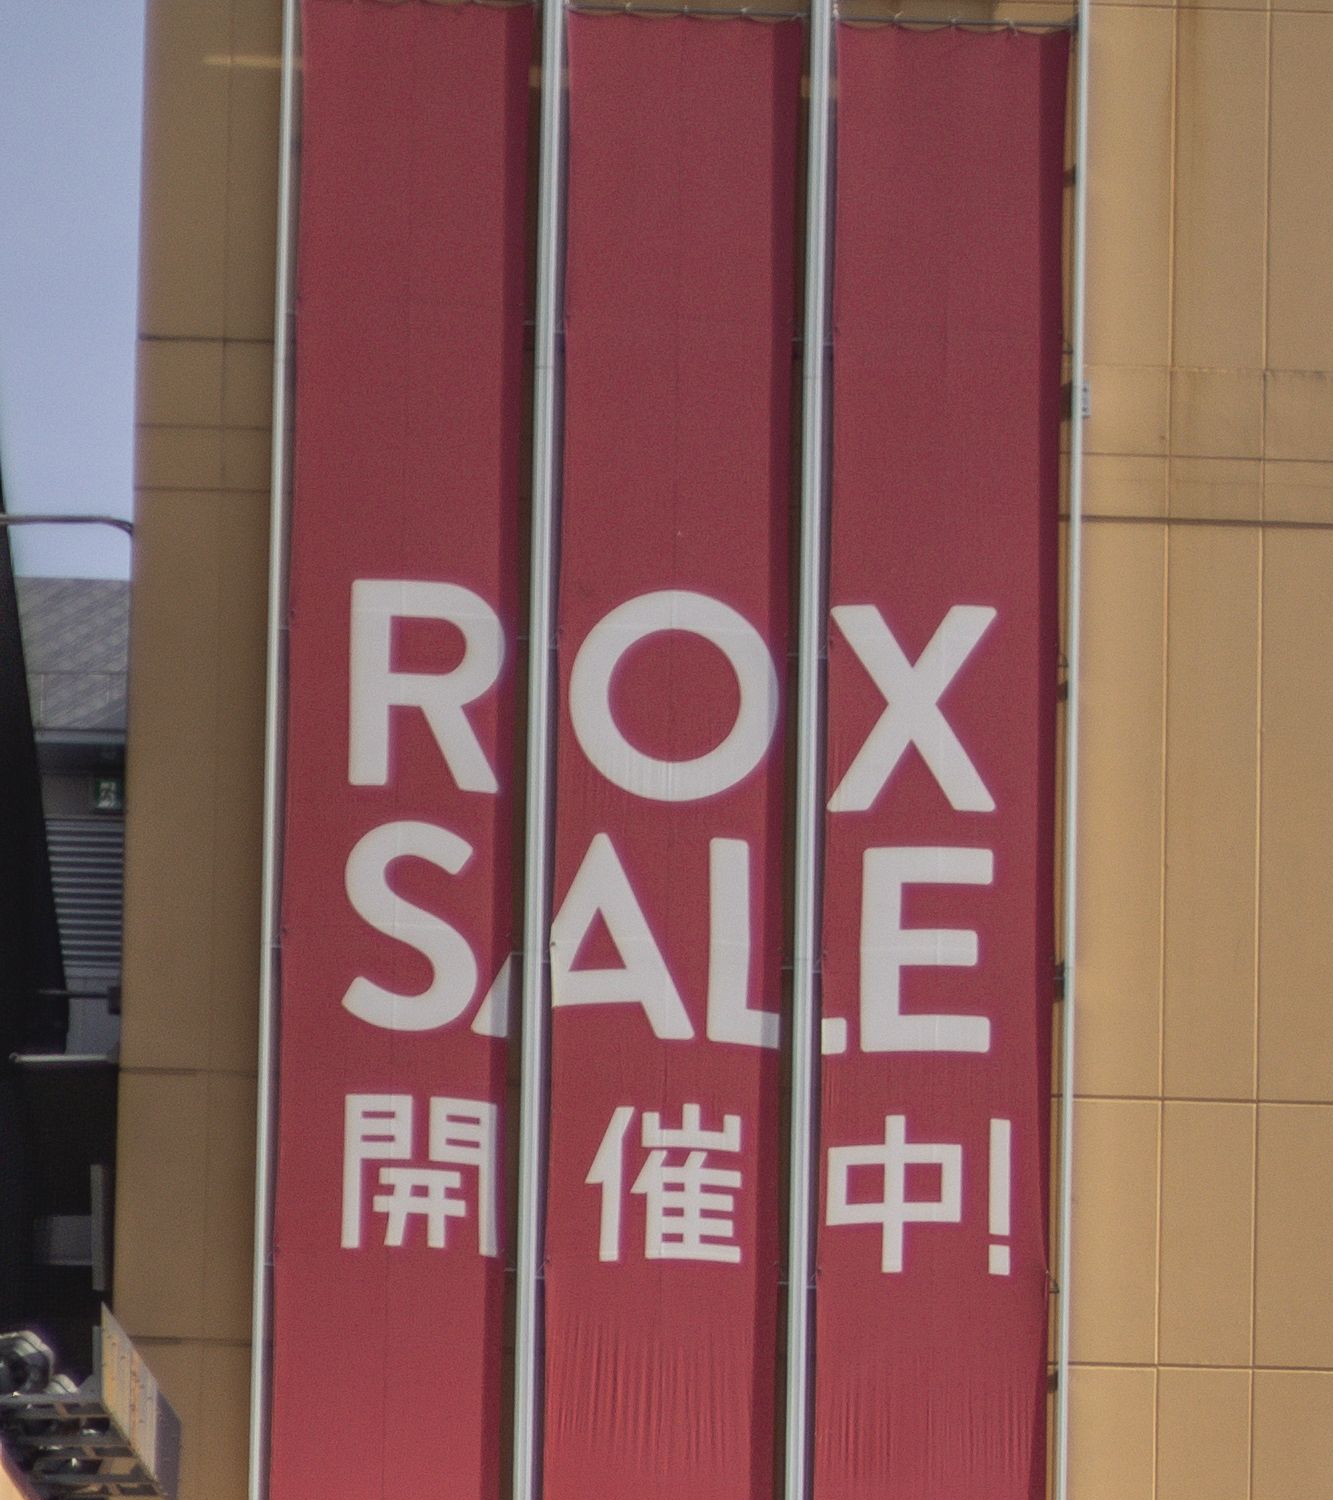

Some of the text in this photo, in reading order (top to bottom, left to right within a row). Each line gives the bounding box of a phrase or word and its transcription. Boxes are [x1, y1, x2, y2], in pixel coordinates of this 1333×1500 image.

[347, 578, 997, 812] ROX
[341, 820, 994, 1056] SALE
[341, 1093, 1012, 1276] 開催中!
